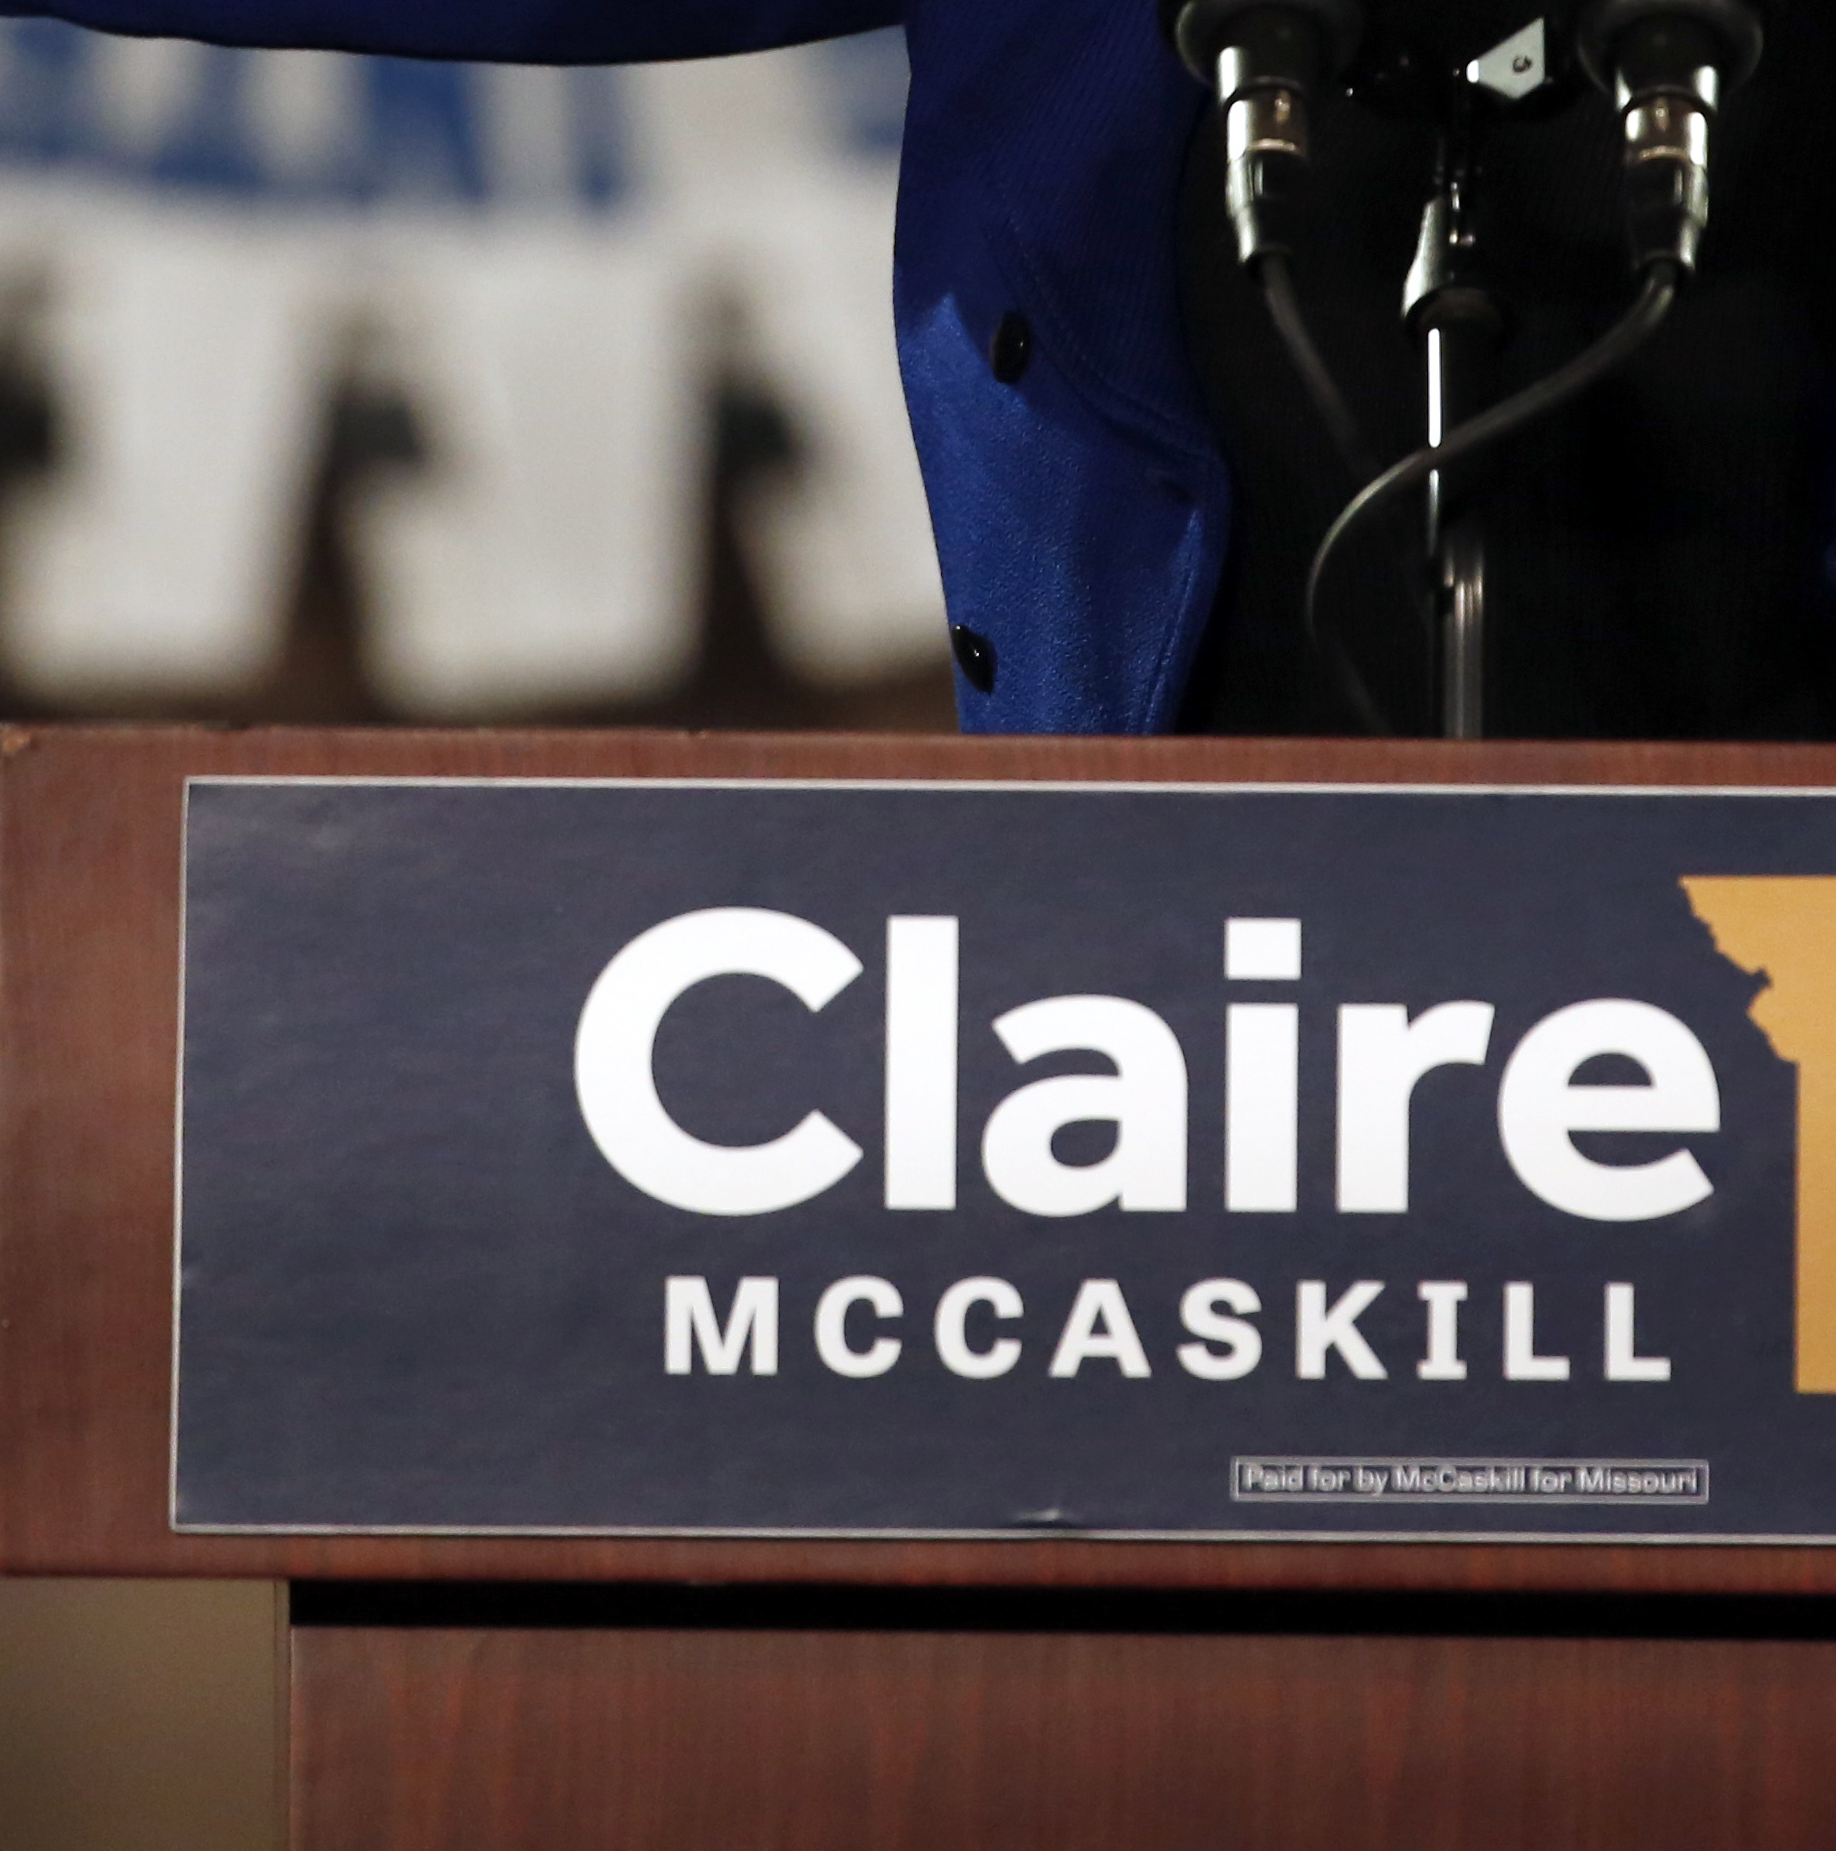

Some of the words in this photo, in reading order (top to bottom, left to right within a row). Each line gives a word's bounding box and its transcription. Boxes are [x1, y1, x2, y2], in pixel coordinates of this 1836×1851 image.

[573, 906, 1722, 1222] Claire
[664, 1274, 1673, 1382] MCCASKILL
[1244, 1463, 1304, 1492] Paid
[1308, 1464, 1351, 1492] for
[1354, 1464, 1388, 1497] by
[1391, 1464, 1525, 1493] McCaskill
[1530, 1466, 1572, 1493] for
[1575, 1467, 1698, 1494] Missouri
